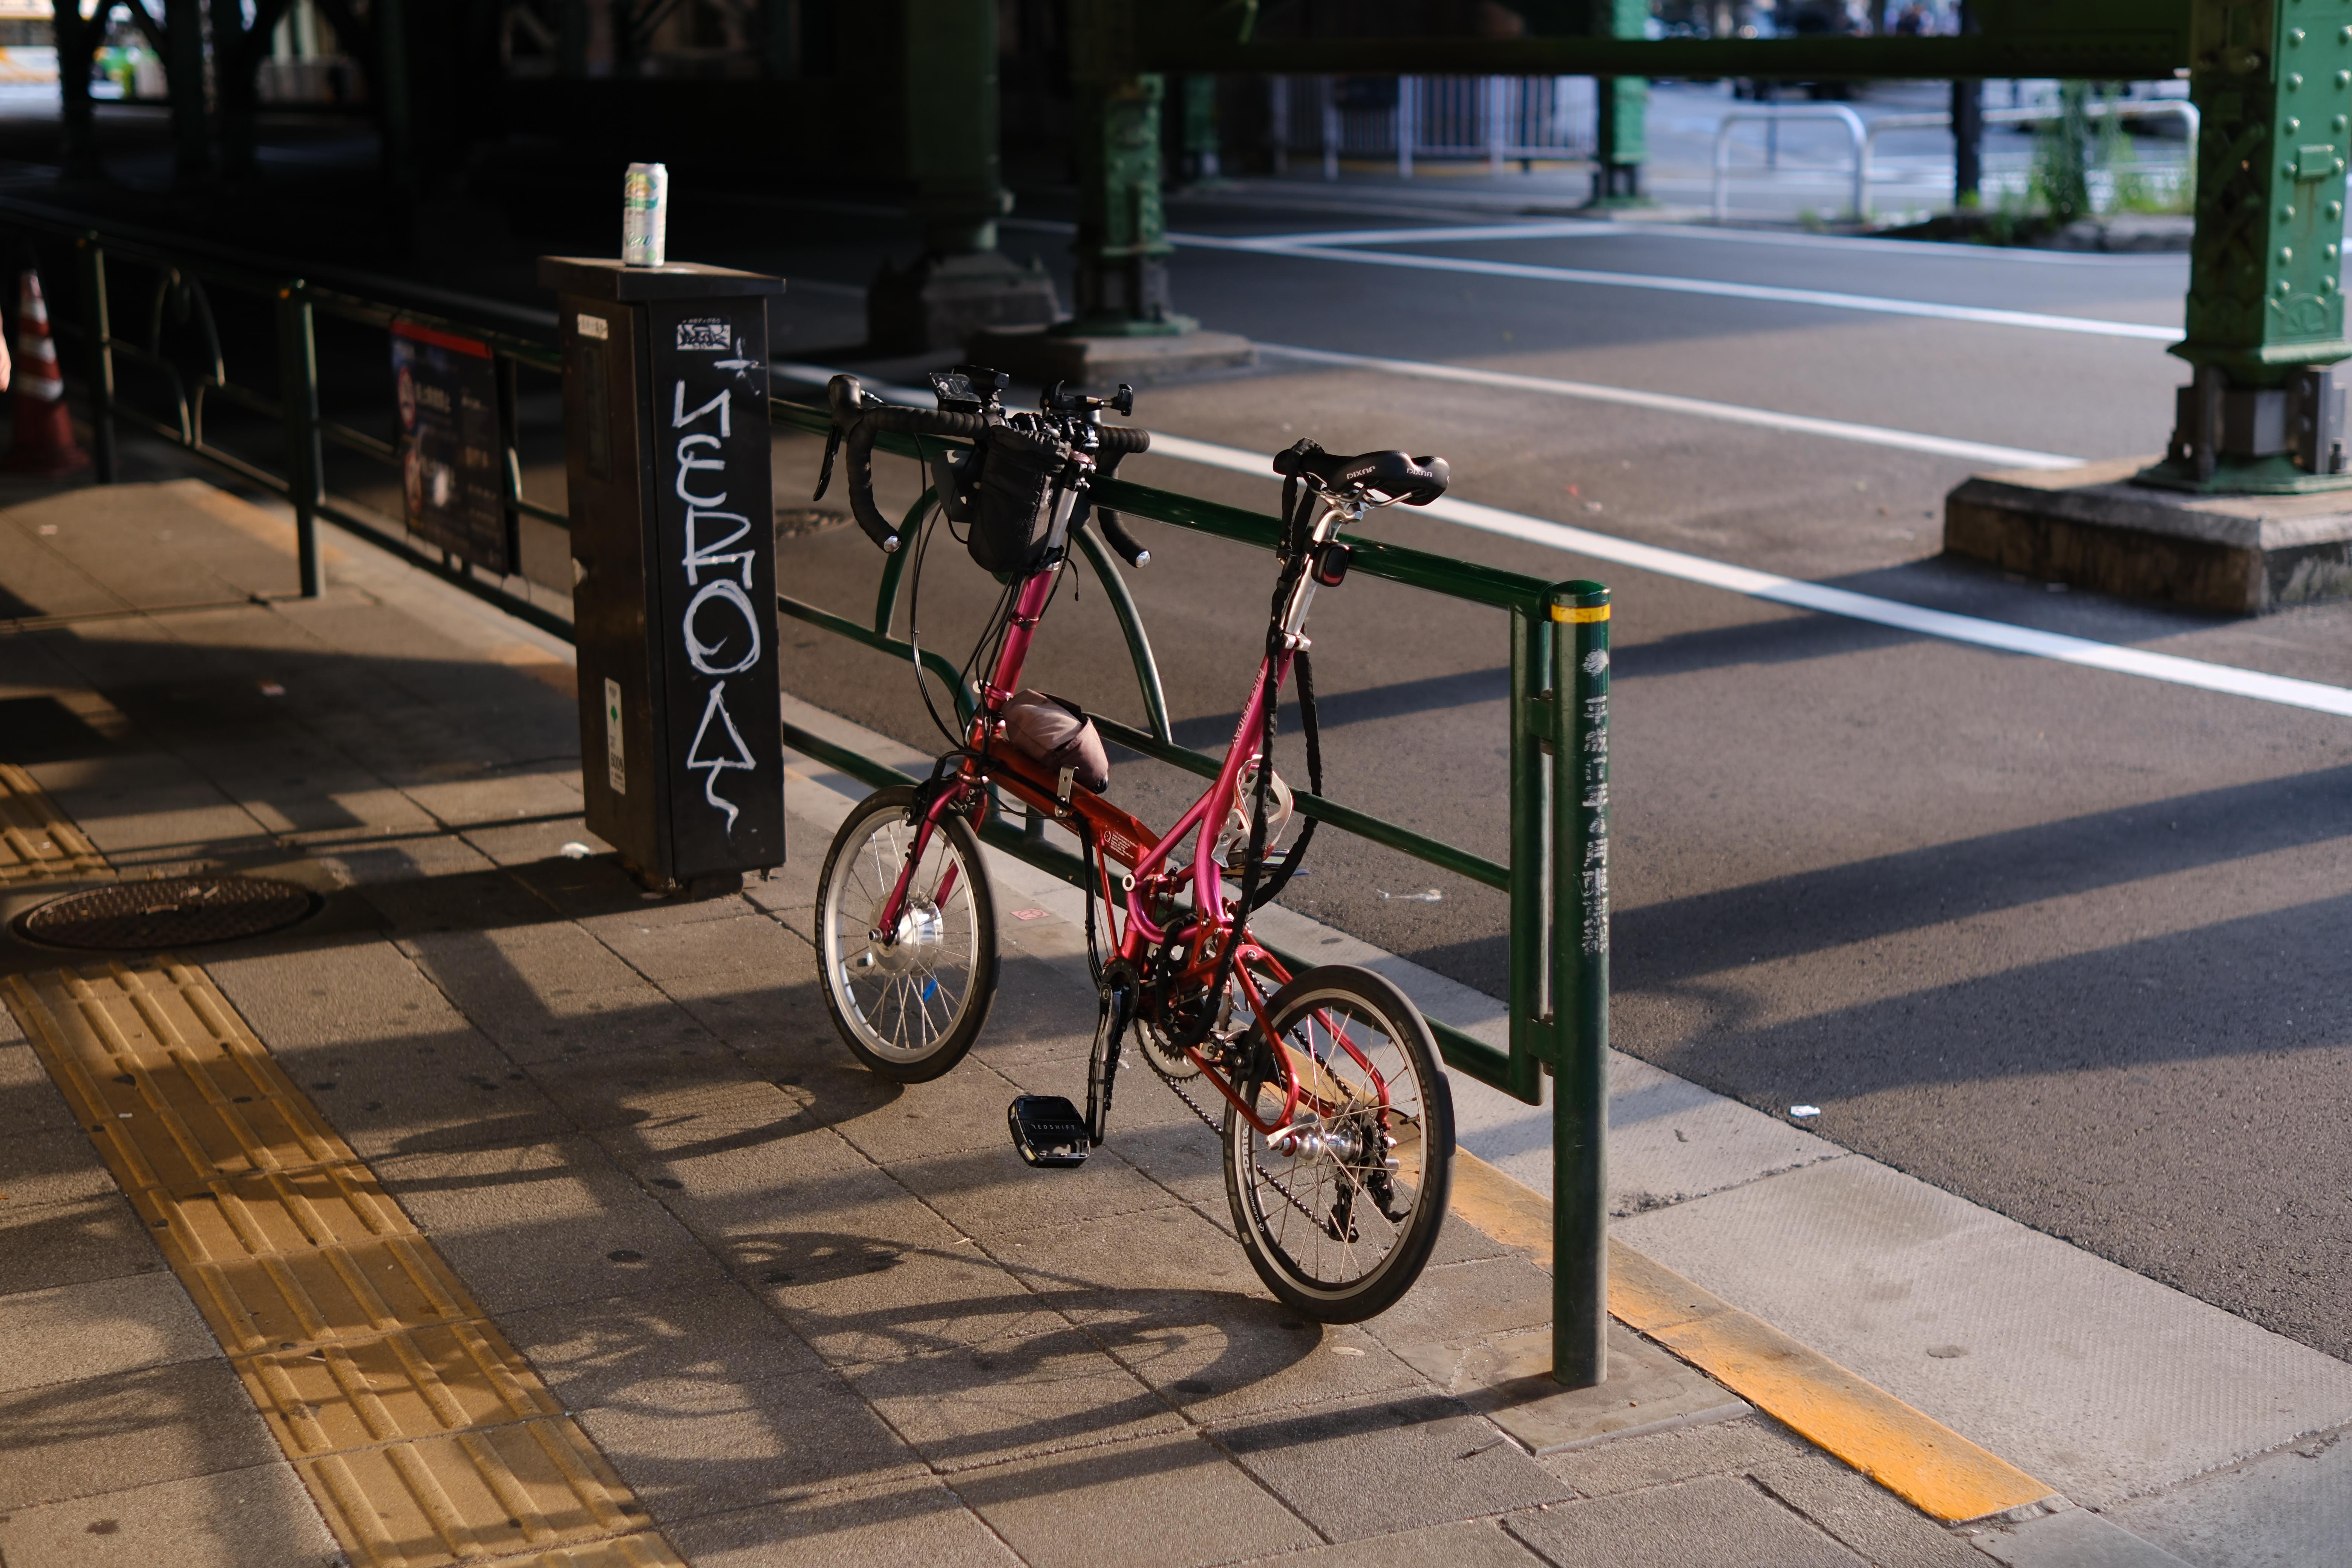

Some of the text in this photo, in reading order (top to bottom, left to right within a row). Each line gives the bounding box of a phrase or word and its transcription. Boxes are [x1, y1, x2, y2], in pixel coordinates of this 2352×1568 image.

[1346, 466, 1376, 479] DIXNA
[1406, 468, 1432, 477] DIXNA
[1232, 701, 1252, 749] FRIDAY
[1248, 1189, 1261, 1222] ALEXRIMS
